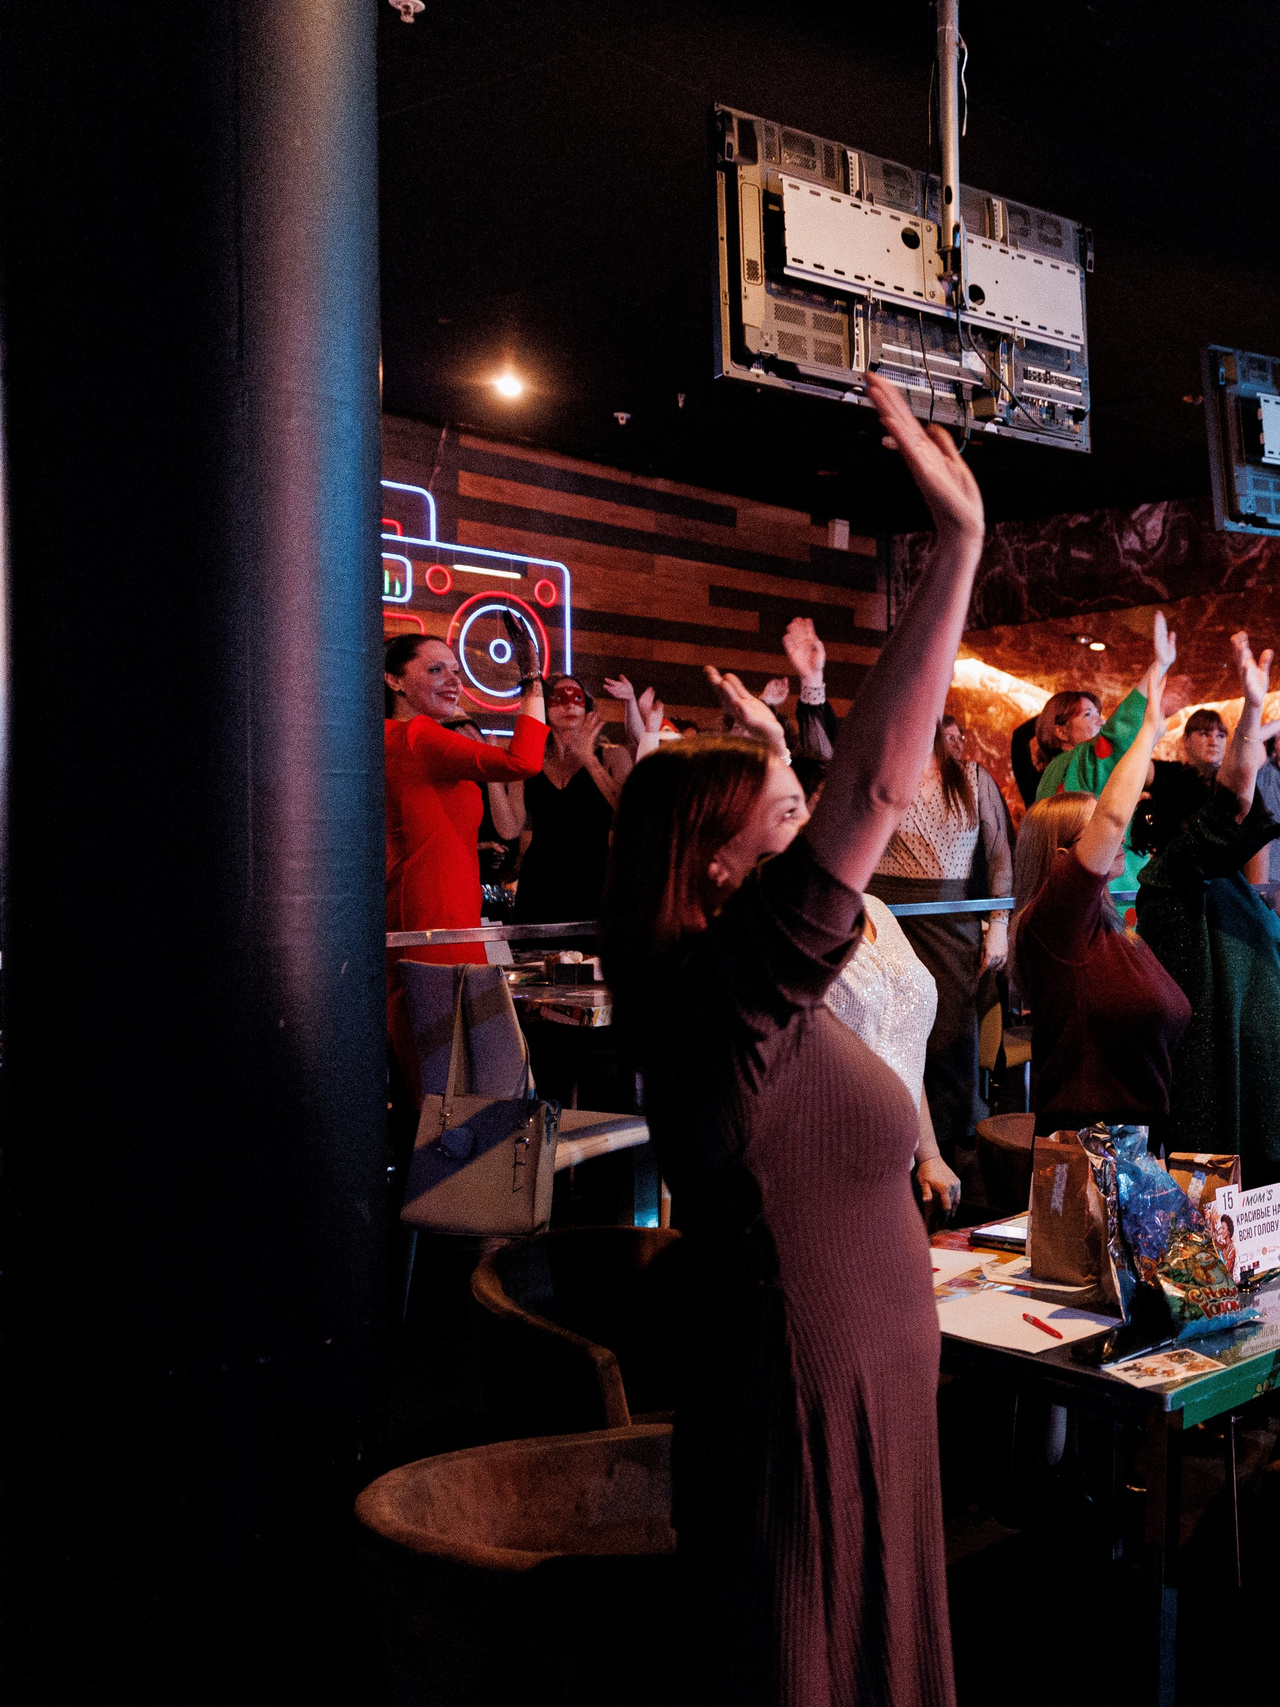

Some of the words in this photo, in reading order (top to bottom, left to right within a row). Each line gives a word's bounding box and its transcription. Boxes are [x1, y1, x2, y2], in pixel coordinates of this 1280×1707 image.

[1222, 1191, 1234, 1211] 15
[1235, 1205, 1271, 1226] КРАСИВЫЕ
[1238, 1229, 1253, 1242] ВСЮ
[1253, 1219, 1280, 1238] ГОЛОВУ
[1188, 1288, 1204, 1304] С
[1200, 1285, 1239, 1300] Новы
